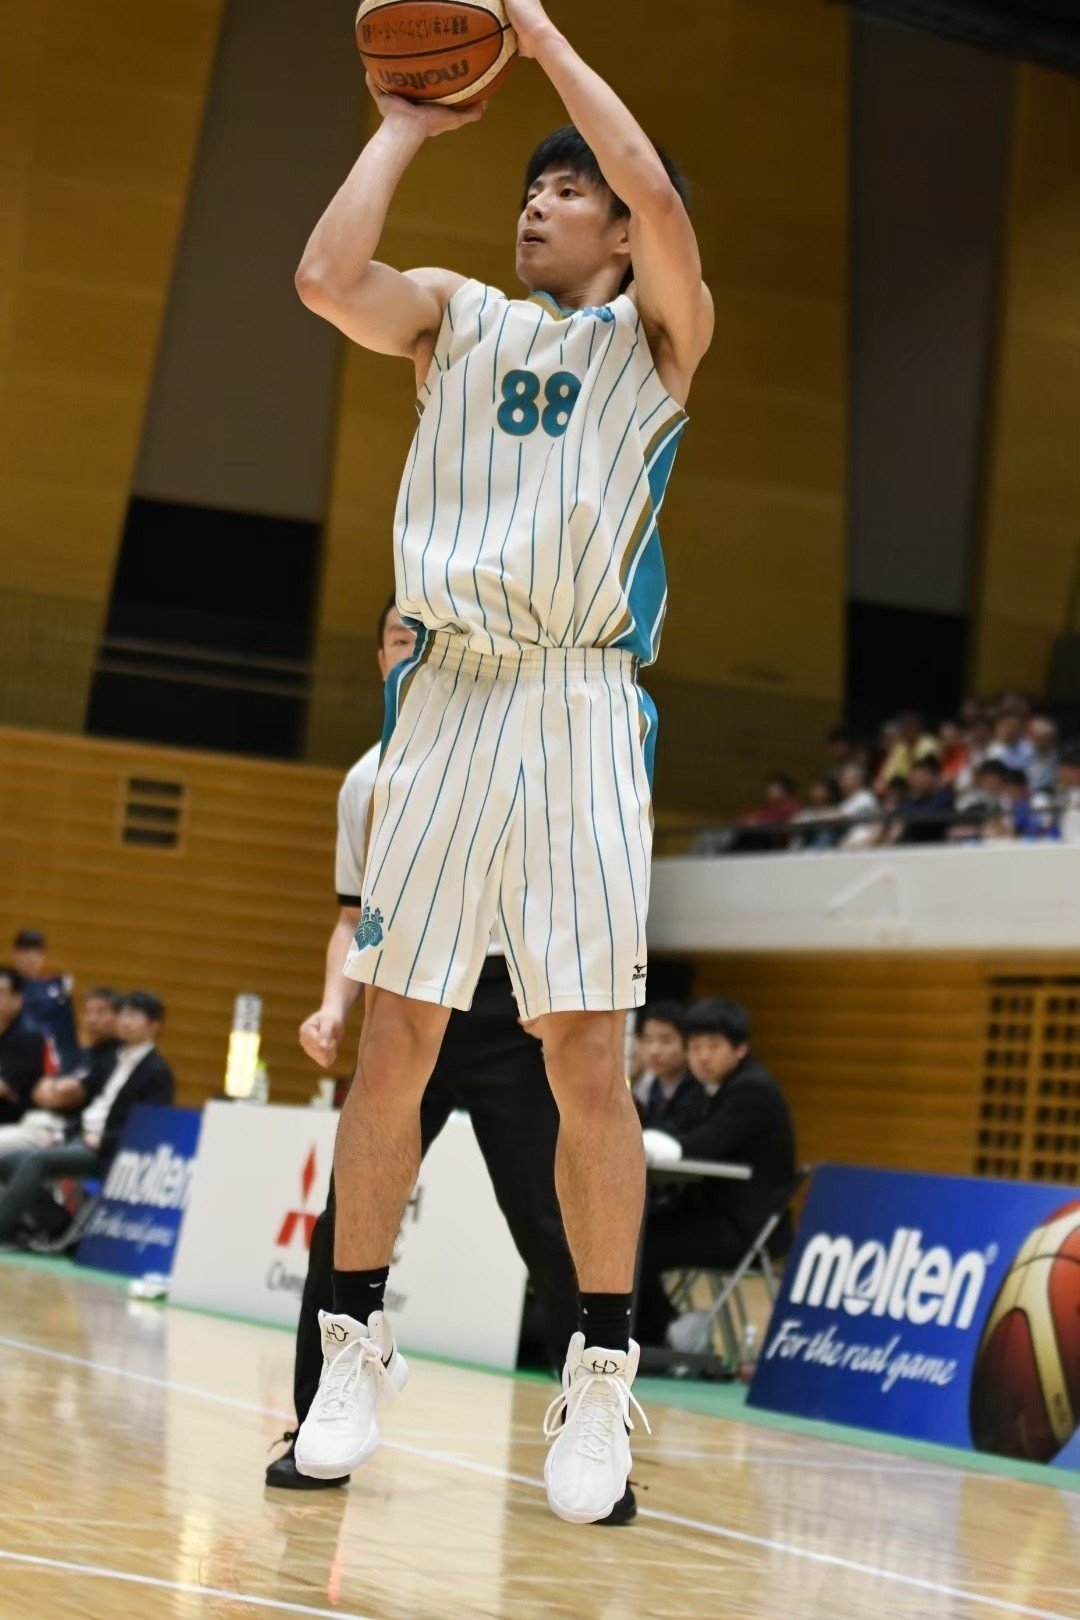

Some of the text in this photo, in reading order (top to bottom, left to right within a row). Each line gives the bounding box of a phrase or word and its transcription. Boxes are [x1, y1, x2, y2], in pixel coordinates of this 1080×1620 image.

[378, 59, 470, 90] molten
[497, 369, 582, 438] 88
[789, 1226, 986, 1331] molten
[765, 1319, 957, 1393] For the real game
